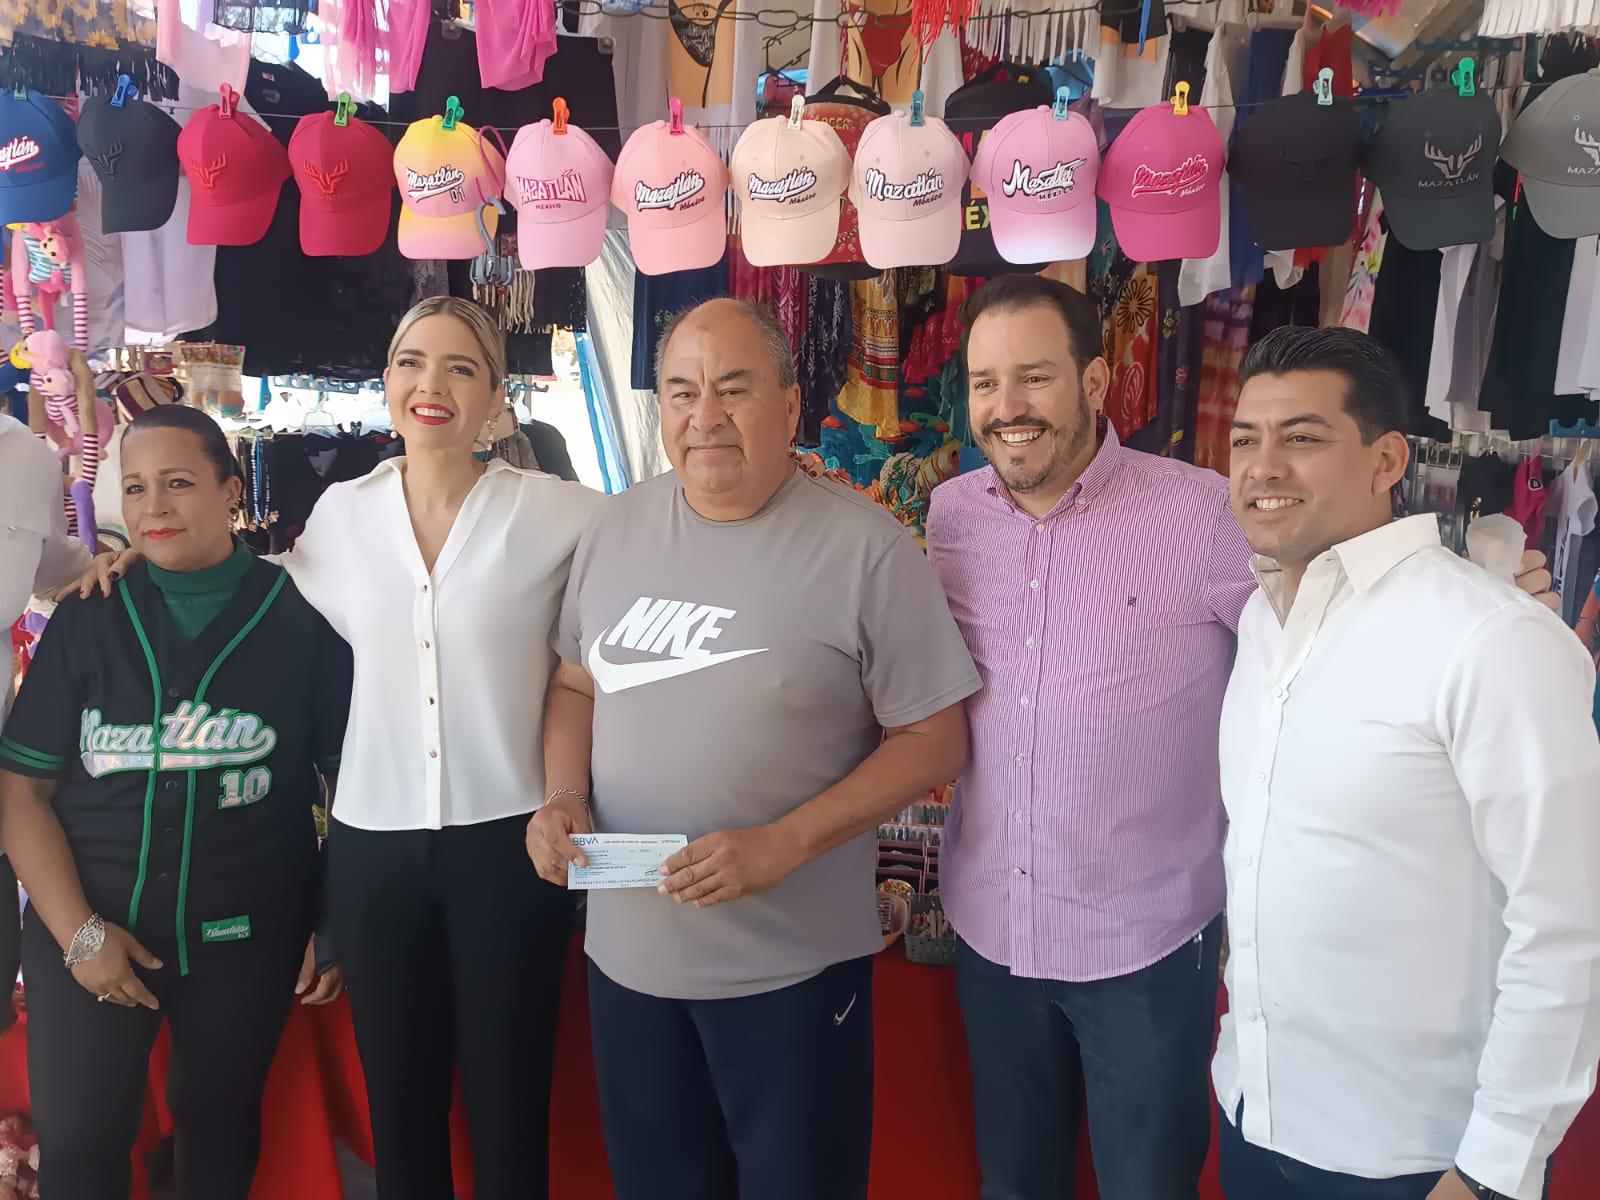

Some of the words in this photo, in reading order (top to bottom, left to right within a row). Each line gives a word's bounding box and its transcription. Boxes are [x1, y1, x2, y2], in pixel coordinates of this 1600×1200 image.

[406, 164, 464, 197] Mazatlán
[450, 186, 466, 203] 01
[517, 169, 587, 203] MAZATLÁN
[635, 168, 705, 209] Mazatlán
[747, 166, 817, 202] Mazatlán
[866, 168, 944, 201] Mazatlán
[605, 596, 737, 659] NIKE
[217, 766, 272, 809] 10
[572, 836, 599, 846] BBVA
